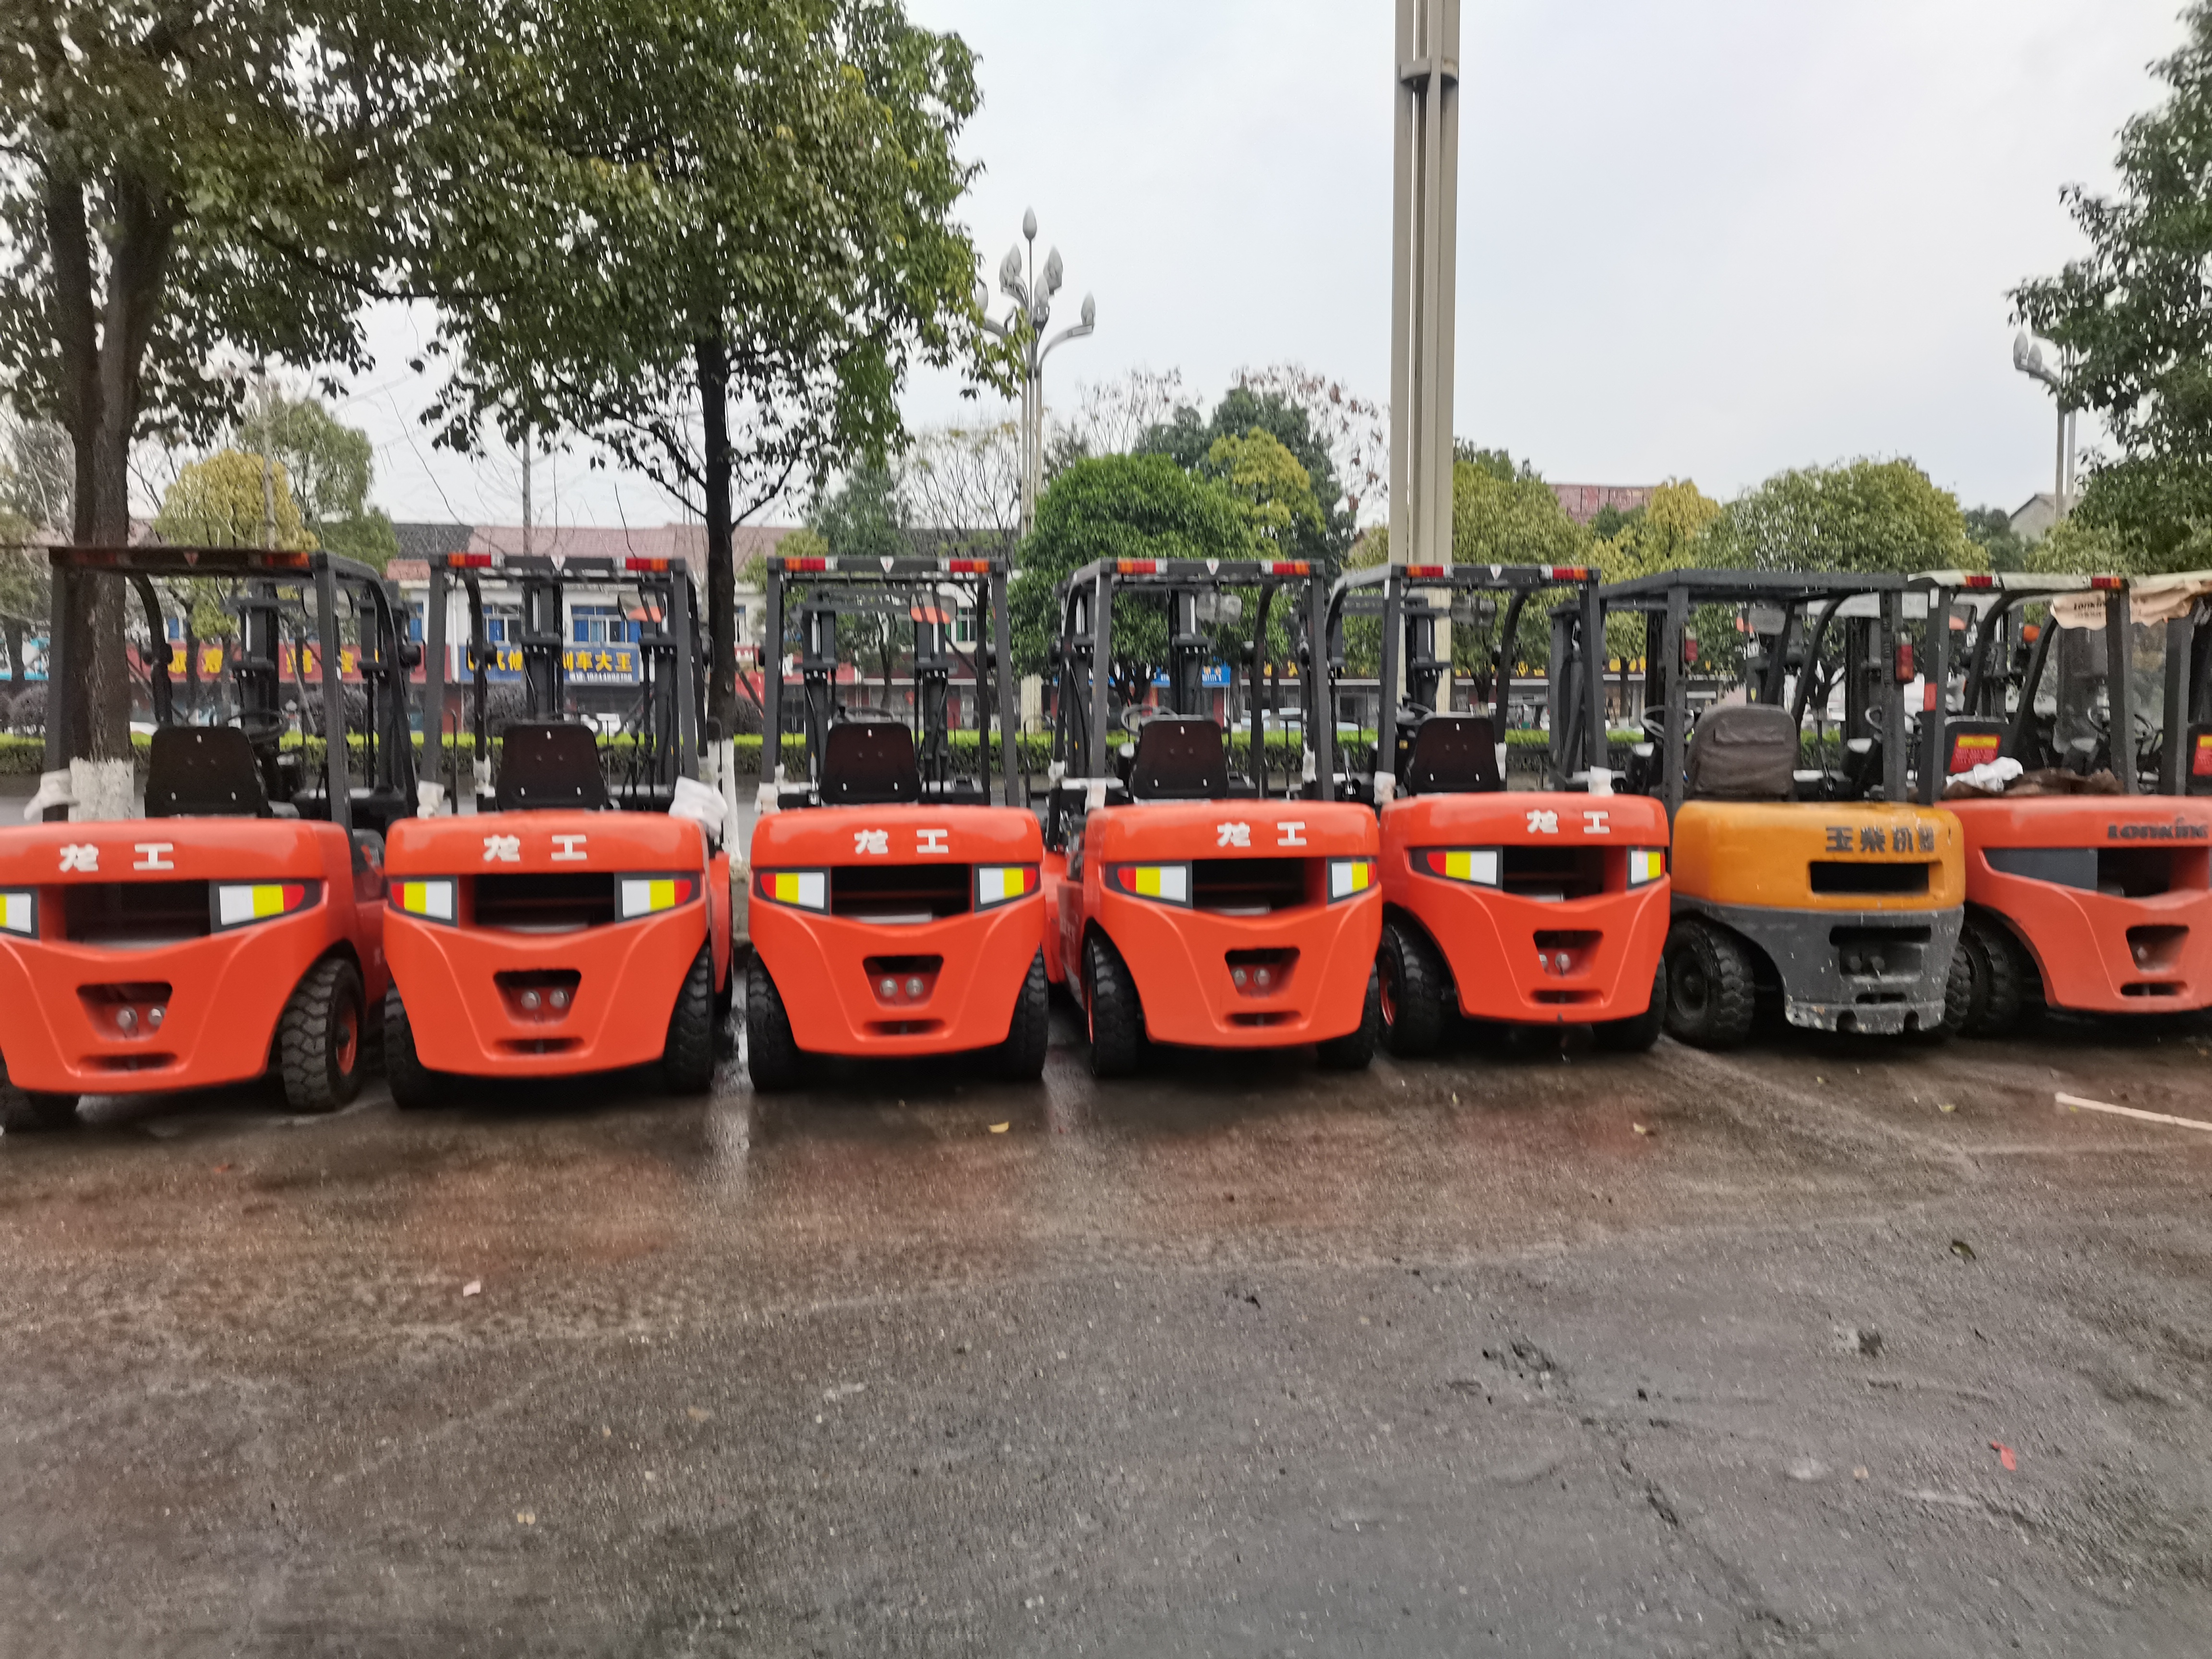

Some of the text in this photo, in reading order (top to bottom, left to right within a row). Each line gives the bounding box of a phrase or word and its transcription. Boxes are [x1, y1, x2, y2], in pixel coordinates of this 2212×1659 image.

[1527, 809, 1610, 833] 龙工
[854, 830, 949, 854] 龙工
[1217, 822, 1307, 846] 龙工
[60, 843, 174, 872] 龙工
[484, 835, 587, 861] 龙工
